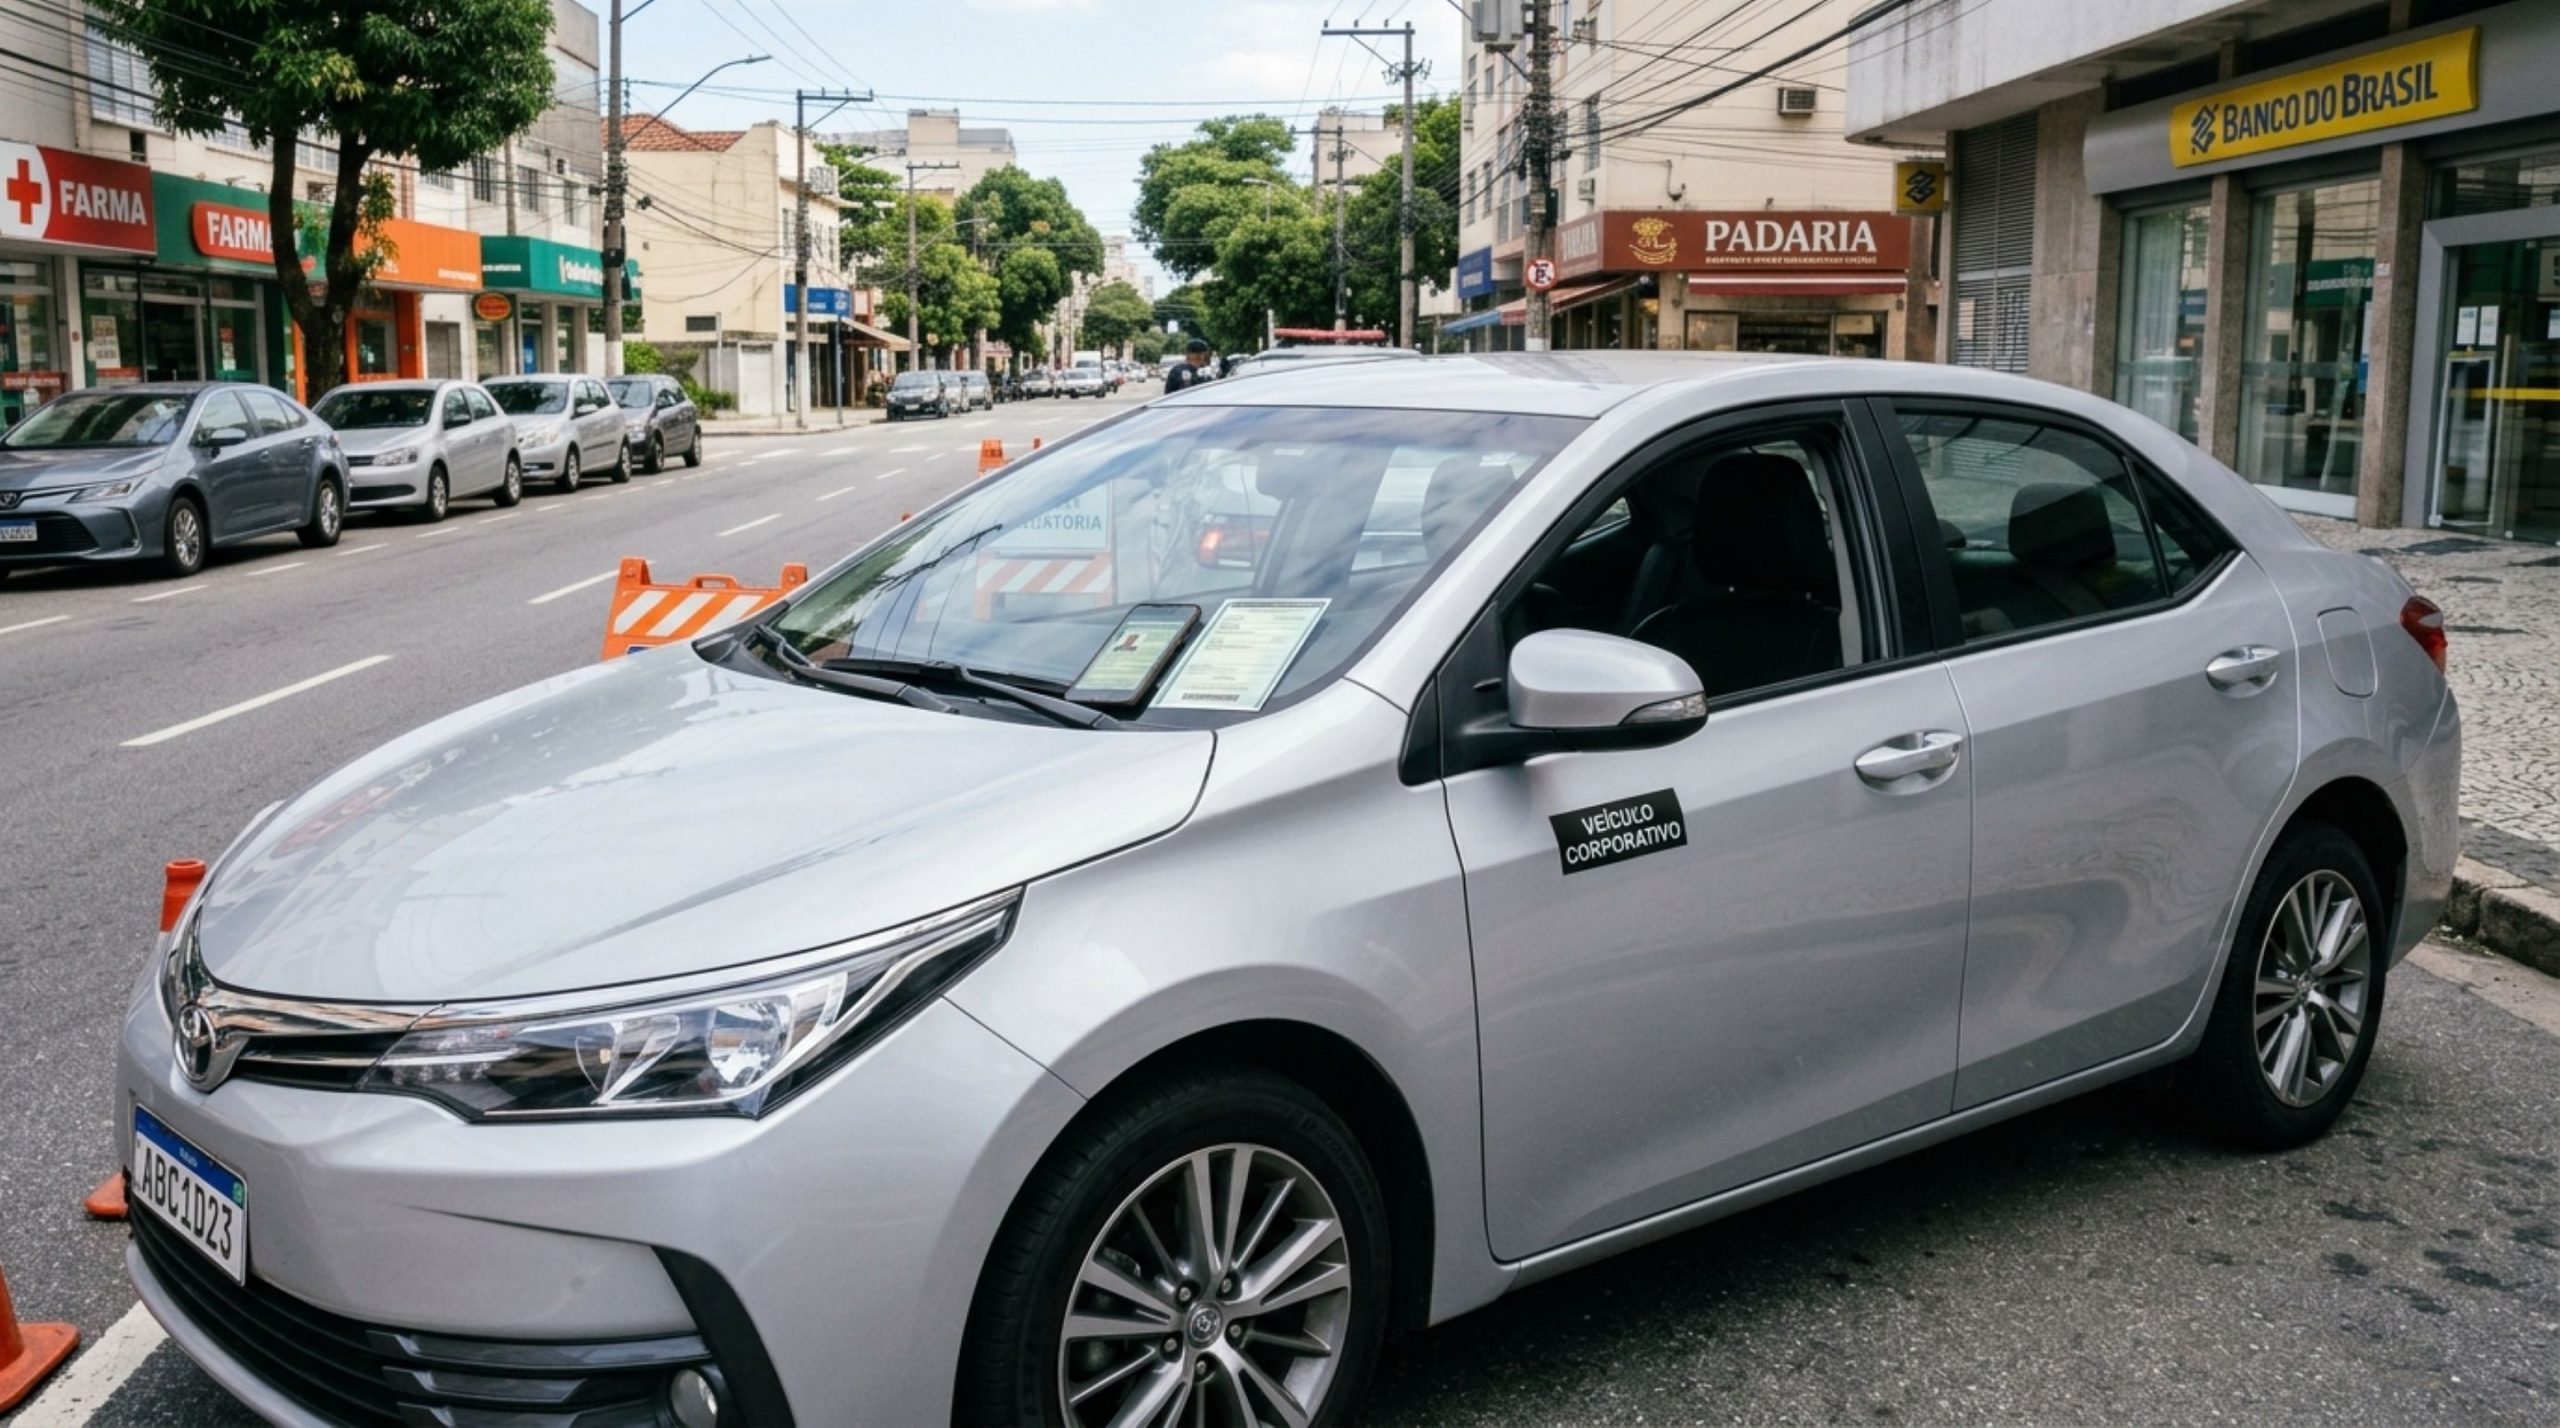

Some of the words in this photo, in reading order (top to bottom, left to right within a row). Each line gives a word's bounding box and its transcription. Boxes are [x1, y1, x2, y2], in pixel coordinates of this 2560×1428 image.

[2223, 94, 2299, 143] BANCO
[2305, 85, 2337, 125] DO
[2342, 61, 2438, 118] BRASIL
[60, 180, 147, 226] FARMA
[1706, 220, 1877, 252] PADARIA
[1581, 804, 1654, 835] VEÍCULO
[1566, 822, 1681, 864] CORPORATIVO
[142, 1147, 233, 1260] ABC1D23
